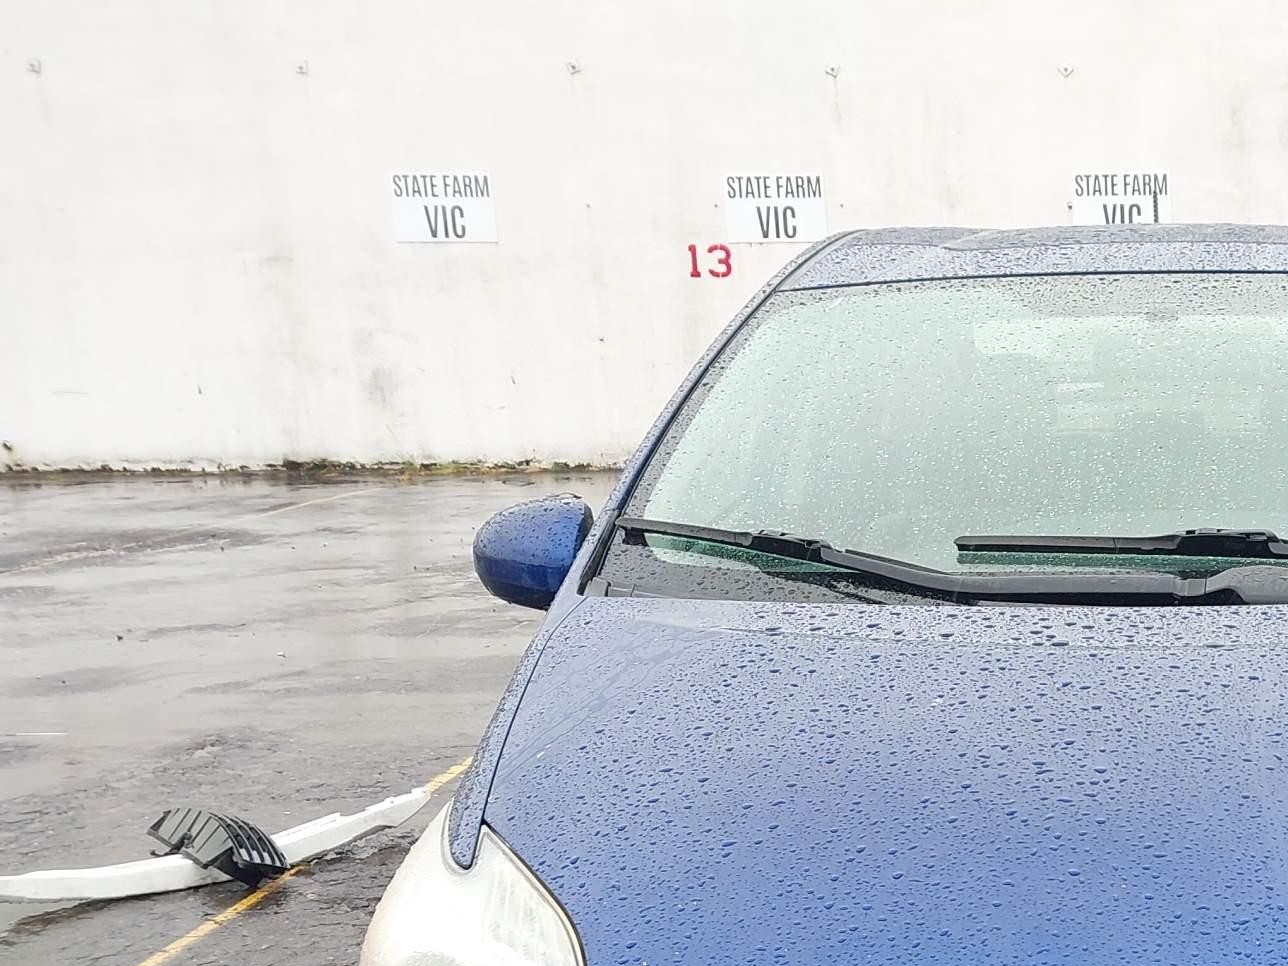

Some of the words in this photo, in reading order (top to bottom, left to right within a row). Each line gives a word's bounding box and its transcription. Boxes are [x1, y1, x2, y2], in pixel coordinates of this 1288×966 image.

[392, 174, 438, 197] STATE
[442, 174, 490, 198] FARM
[726, 176, 772, 199] STATE
[775, 175, 822, 198] FARM
[1074, 174, 1119, 197] STATE
[1123, 173, 1168, 196] FARM
[423, 205, 466, 239] VIC
[756, 205, 797, 239] VIC
[687, 243, 733, 279] 13
